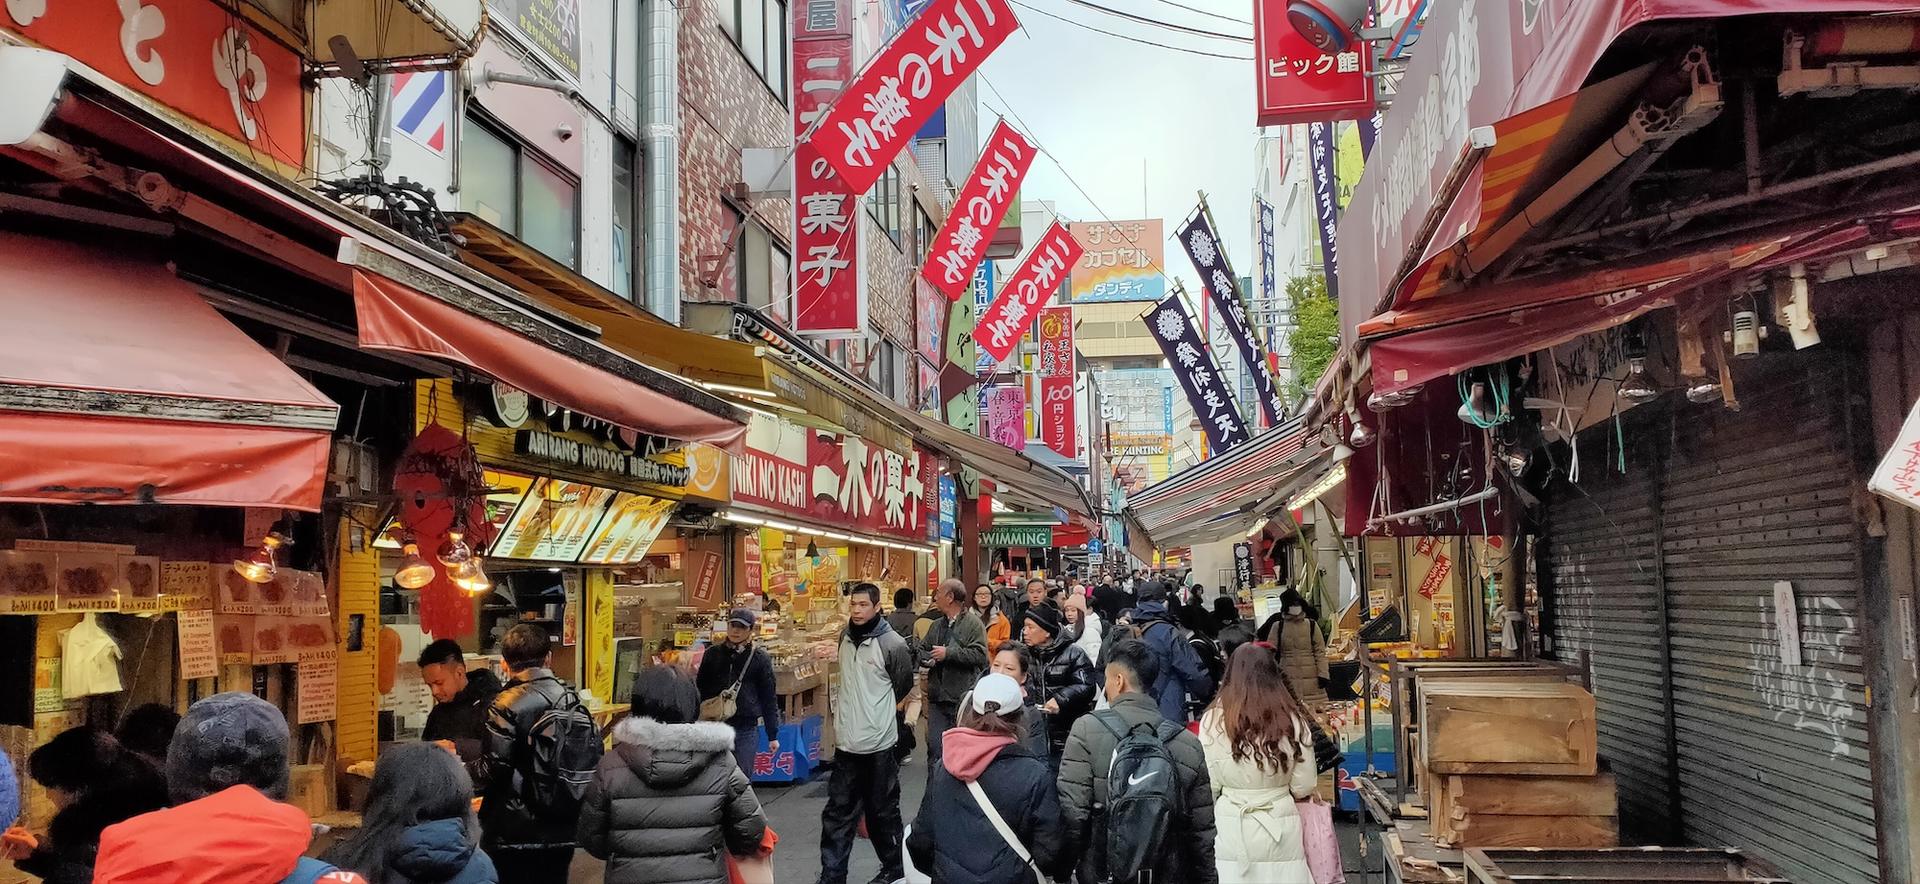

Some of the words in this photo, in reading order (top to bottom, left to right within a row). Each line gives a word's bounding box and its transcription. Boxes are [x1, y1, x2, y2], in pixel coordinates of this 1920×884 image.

[5, 0, 268, 141] とや
[838, 0, 996, 168] 二木の菓子
[1268, 51, 1360, 78] ビック館
[936, 137, 1022, 284] 二木の菓子
[1087, 224, 1147, 244] サウナ
[1083, 250, 1153, 270] カプセル
[986, 234, 1070, 350] 二木の菓子
[1093, 280, 1145, 296] ダンディ
[1044, 384, 1073, 405] 100
[528, 430, 579, 463] ARIRANG
[582, 443, 626, 473] HOTDOG
[1053, 403, 1065, 452] 円ショップ
[732, 453, 757, 497] NIKI
[759, 457, 777, 502] NO
[778, 463, 807, 509] KASHI
[812, 429, 923, 531] 二木の菓子
